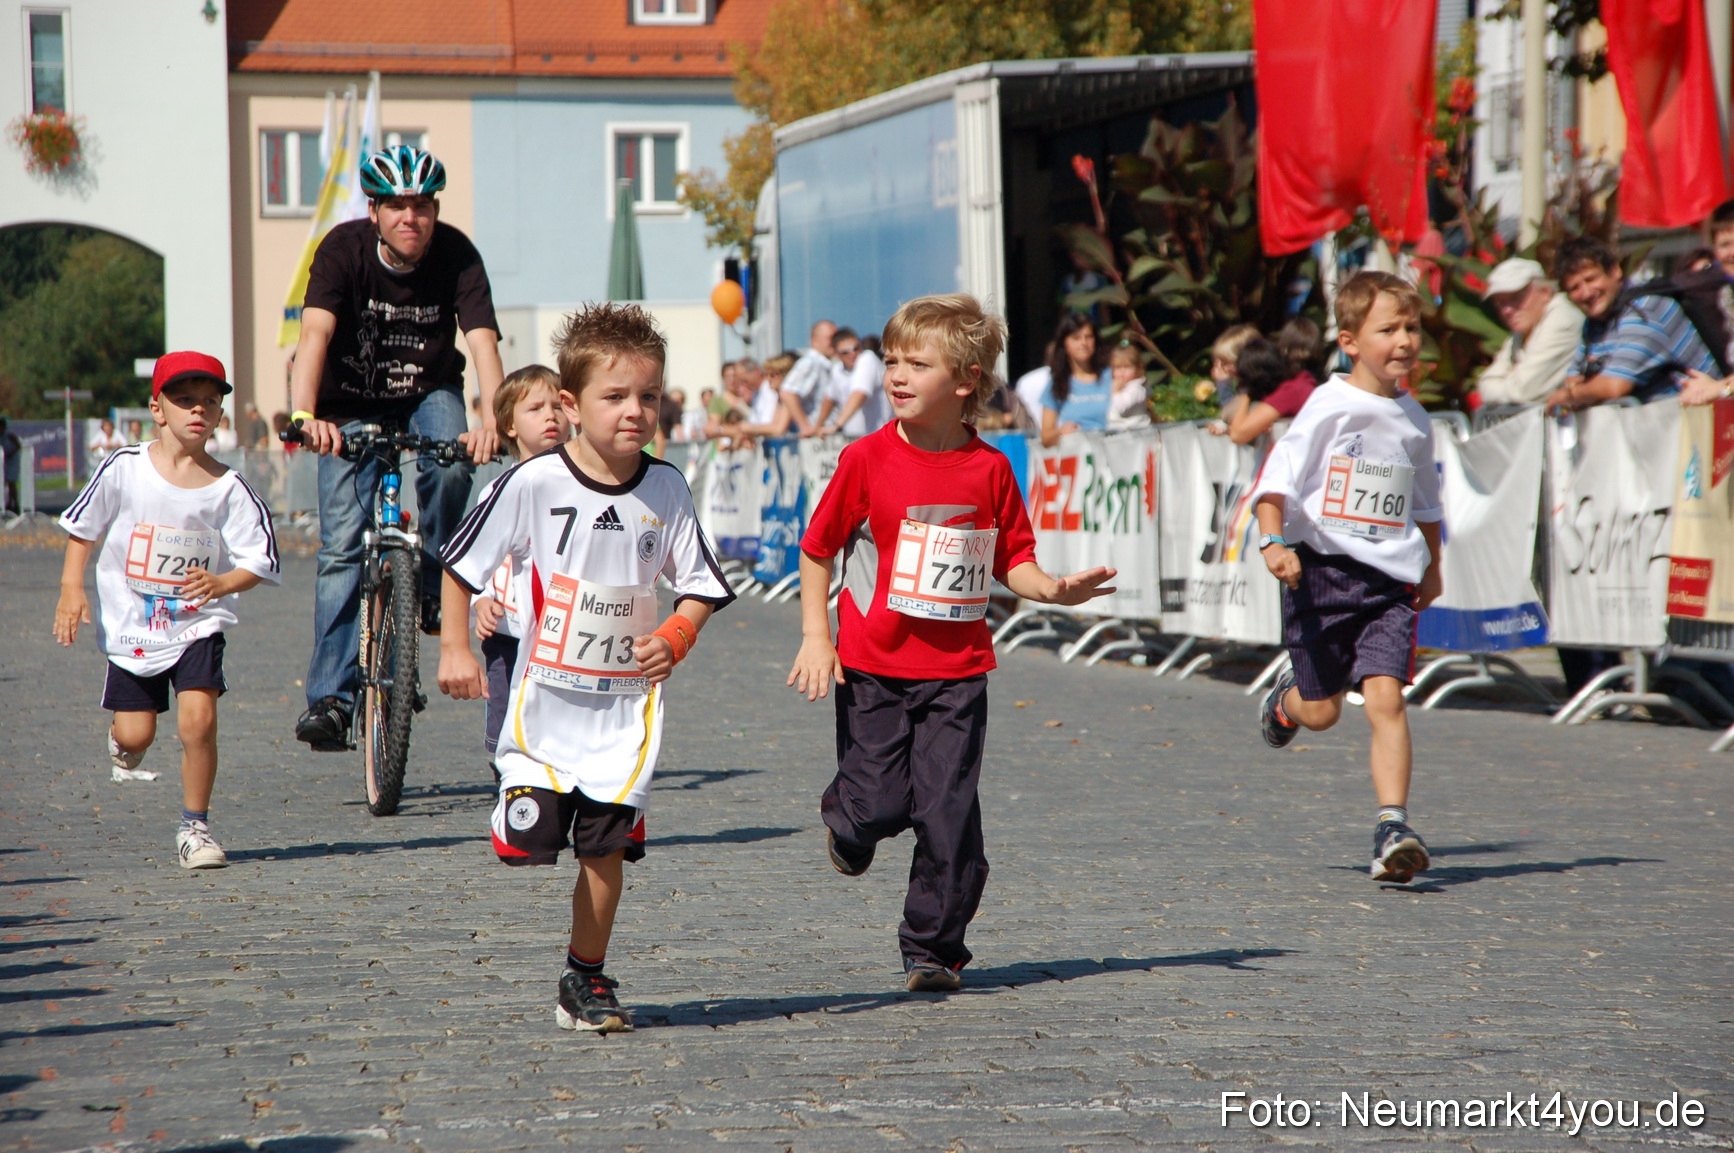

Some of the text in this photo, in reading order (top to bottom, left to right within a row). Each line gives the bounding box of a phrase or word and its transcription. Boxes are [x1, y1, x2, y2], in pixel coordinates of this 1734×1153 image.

[1356, 459, 1394, 478] Daniel
[1330, 479, 1342, 492] K2
[1354, 488, 1405, 517] 7160
[550, 506, 578, 556] 7
[592, 521, 625, 532] adidas
[156, 532, 214, 548] LORENZ
[933, 531, 990, 566] HENRY
[931, 562, 986, 592] 7211
[580, 592, 635, 617] Marcel
[543, 614, 561, 633] K2
[577, 631, 635, 665] 713
[611, 676, 654, 687] PFLEIDERE
